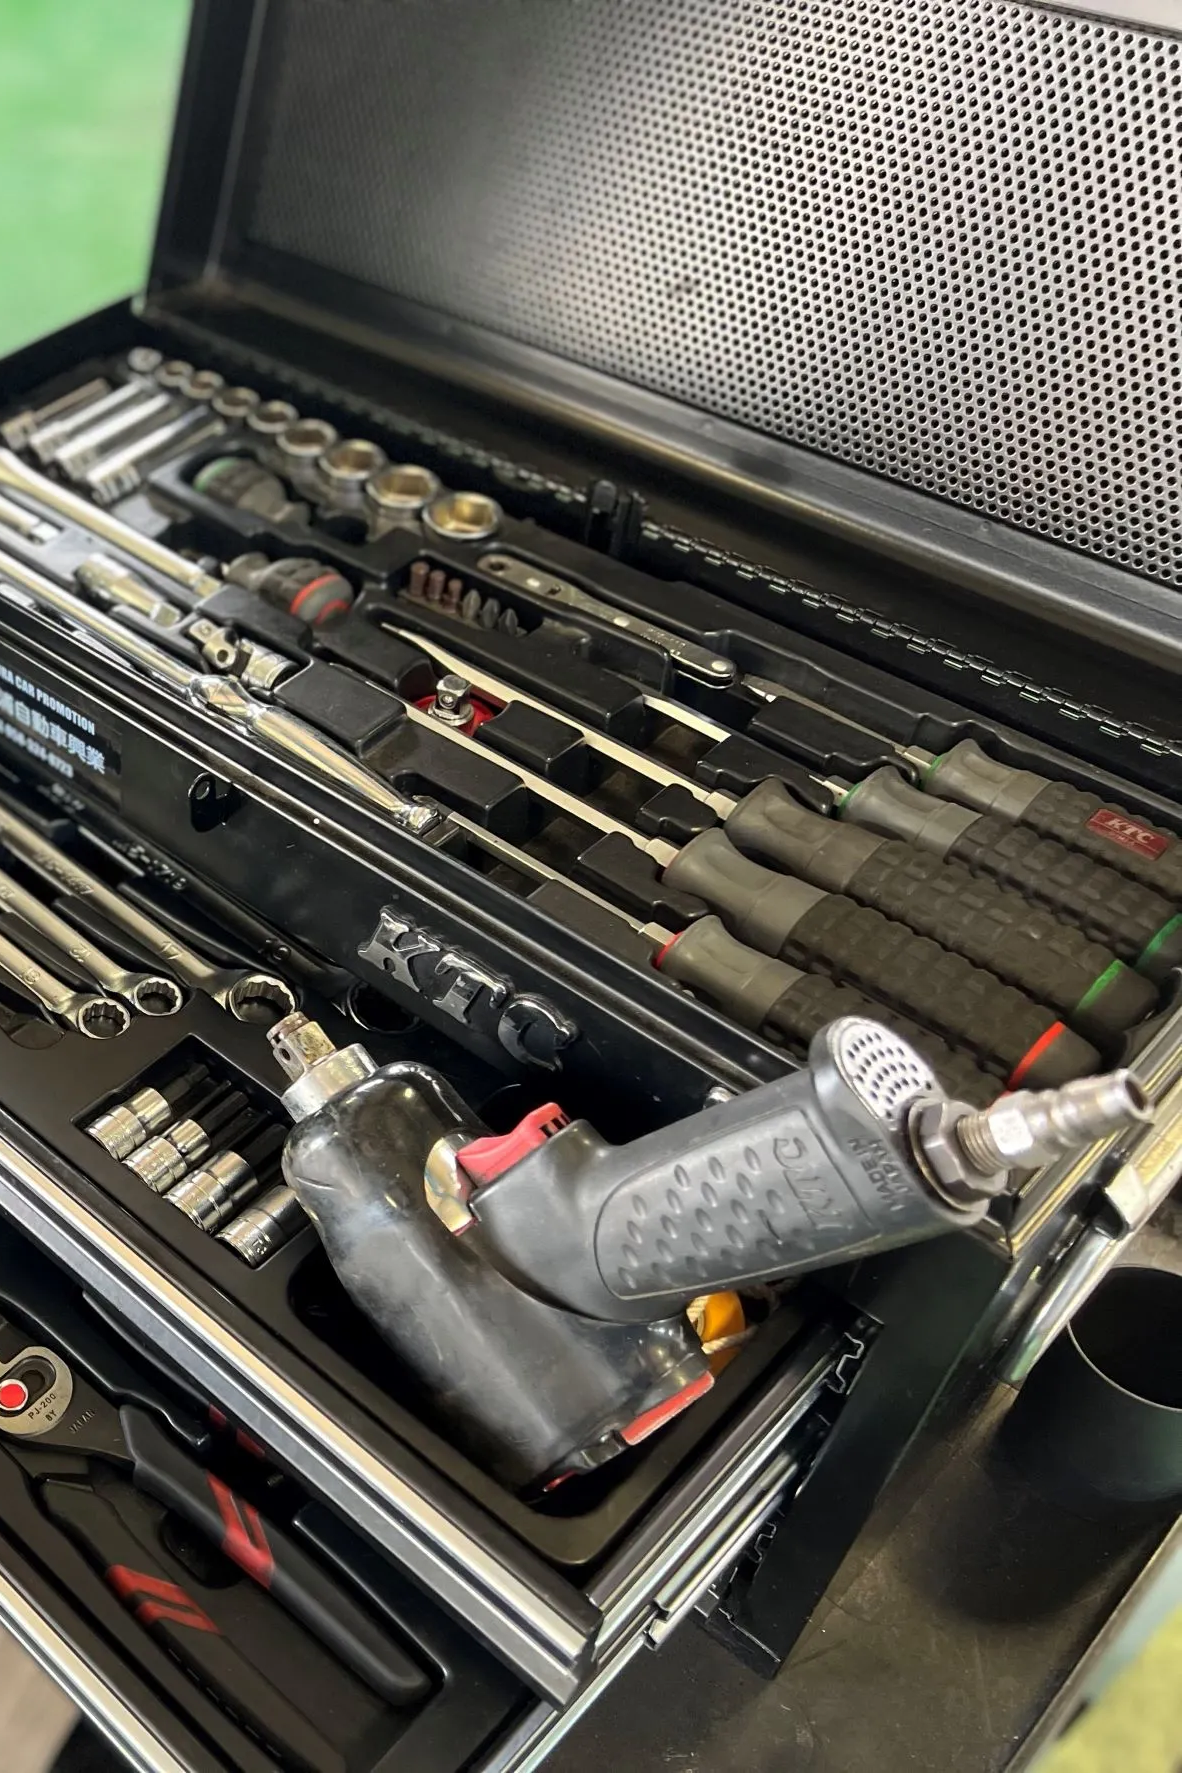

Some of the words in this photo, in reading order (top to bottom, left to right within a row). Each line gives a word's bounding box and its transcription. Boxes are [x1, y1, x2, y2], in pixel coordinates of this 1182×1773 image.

[15, 676, 35, 698] CAR
[37, 688, 95, 735] PROMOTION
[1105, 818, 1154, 844] KTC
[357, 905, 579, 1072] KTC
[773, 1137, 841, 1229] KTC
[27, 1393, 57, 1420] PJ-200
